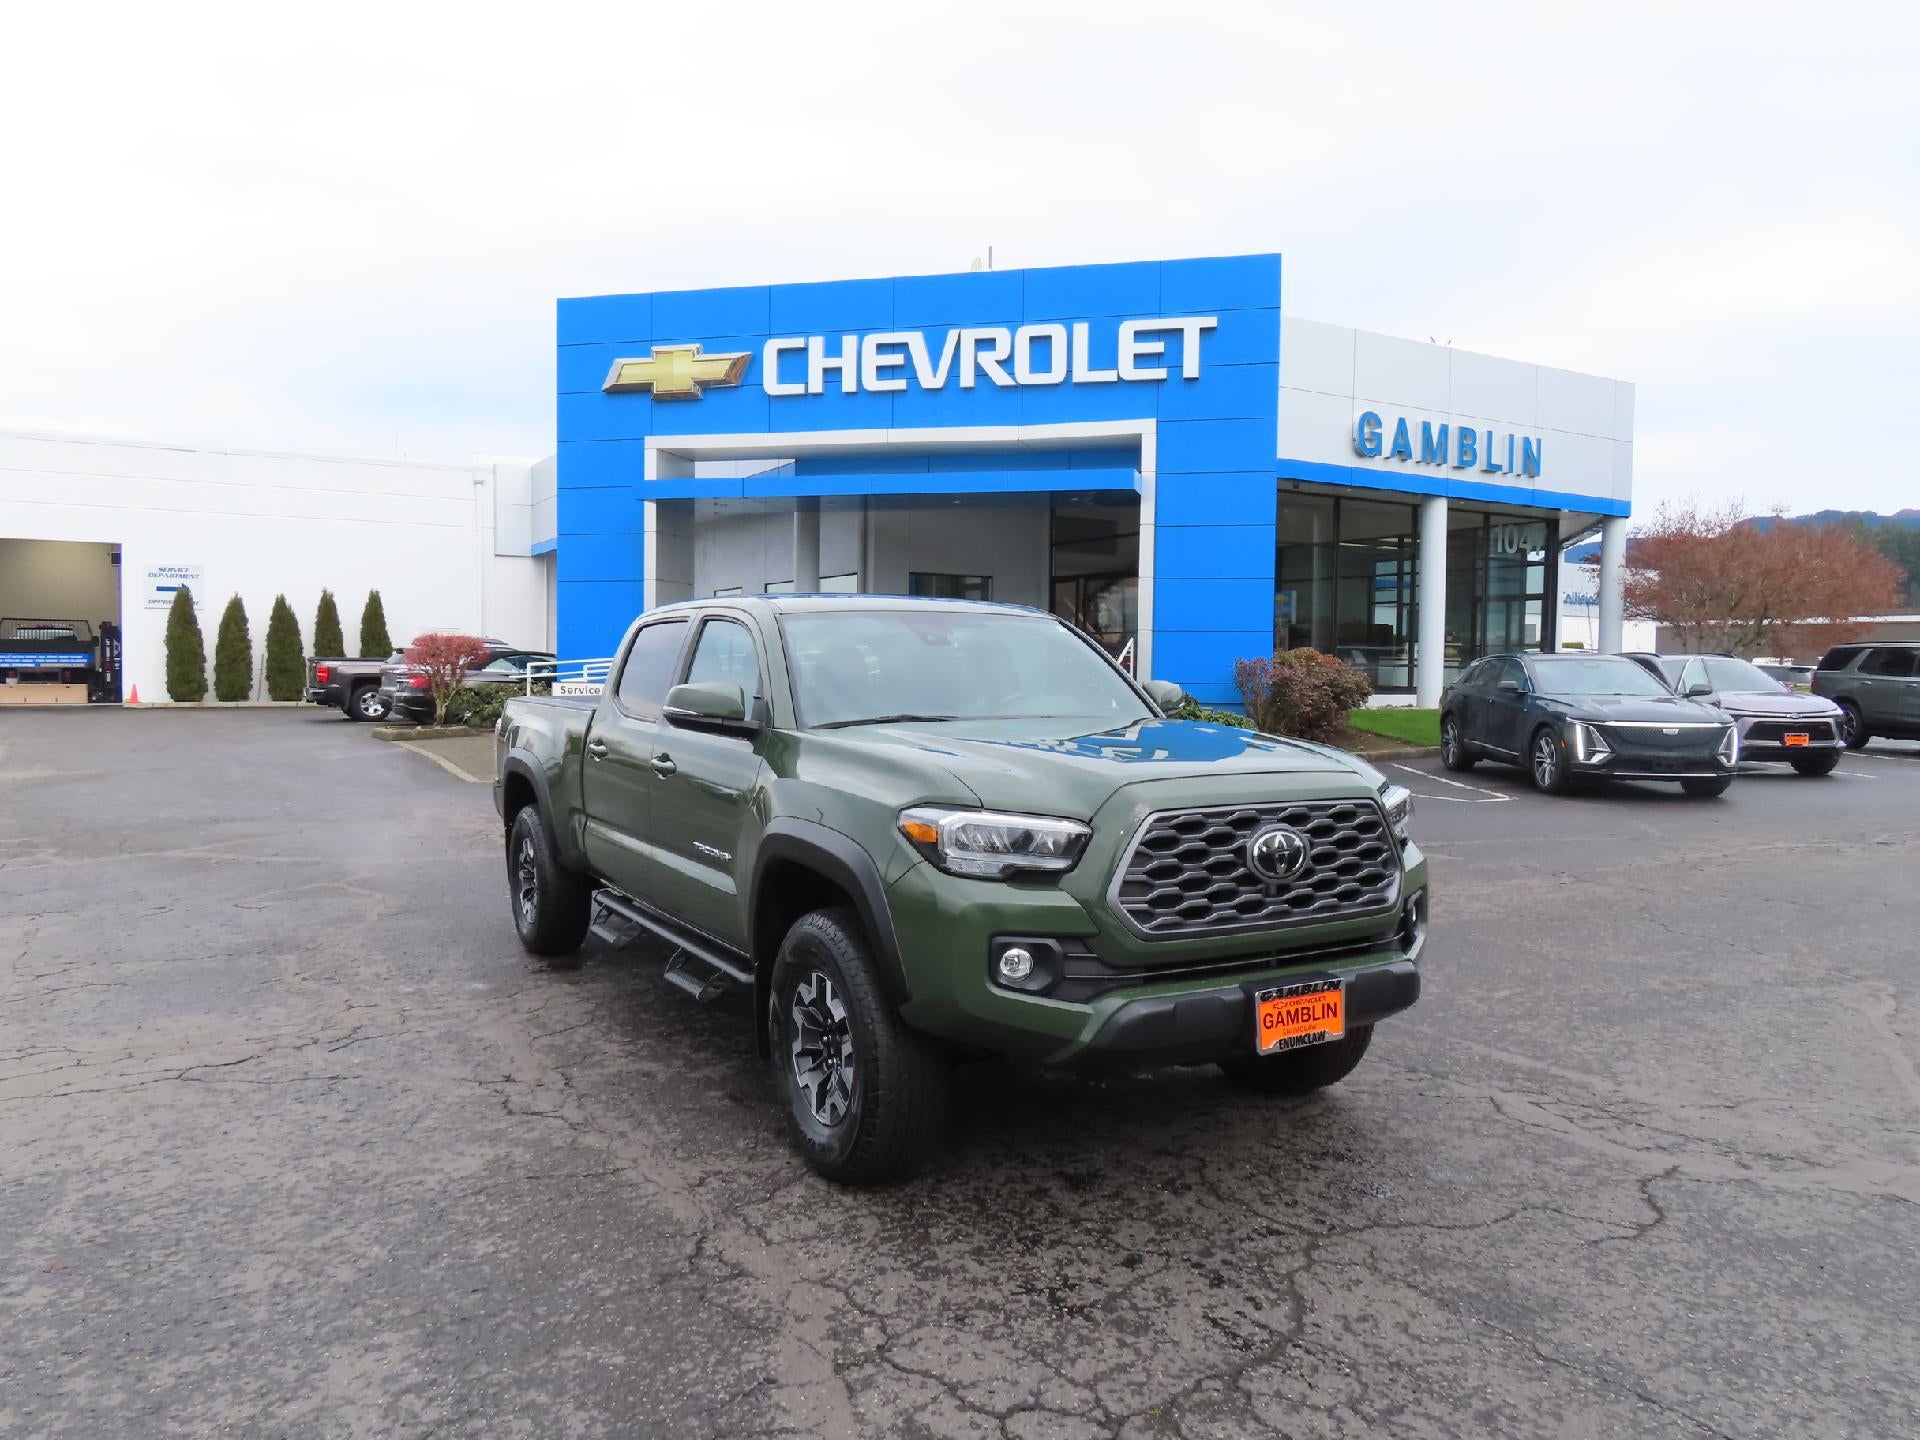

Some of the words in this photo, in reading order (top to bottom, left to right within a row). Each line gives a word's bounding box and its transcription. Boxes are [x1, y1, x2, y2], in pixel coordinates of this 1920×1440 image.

[763, 316, 1217, 396] CHEVROLET
[1354, 411, 1542, 478] GAMBLIN
[148, 572, 200, 580] DEPARTMENT
[560, 685, 601, 695] Service
[1263, 1002, 1338, 1030] GAMBLIN
[1279, 1030, 1327, 1050] ENUMCLAW
